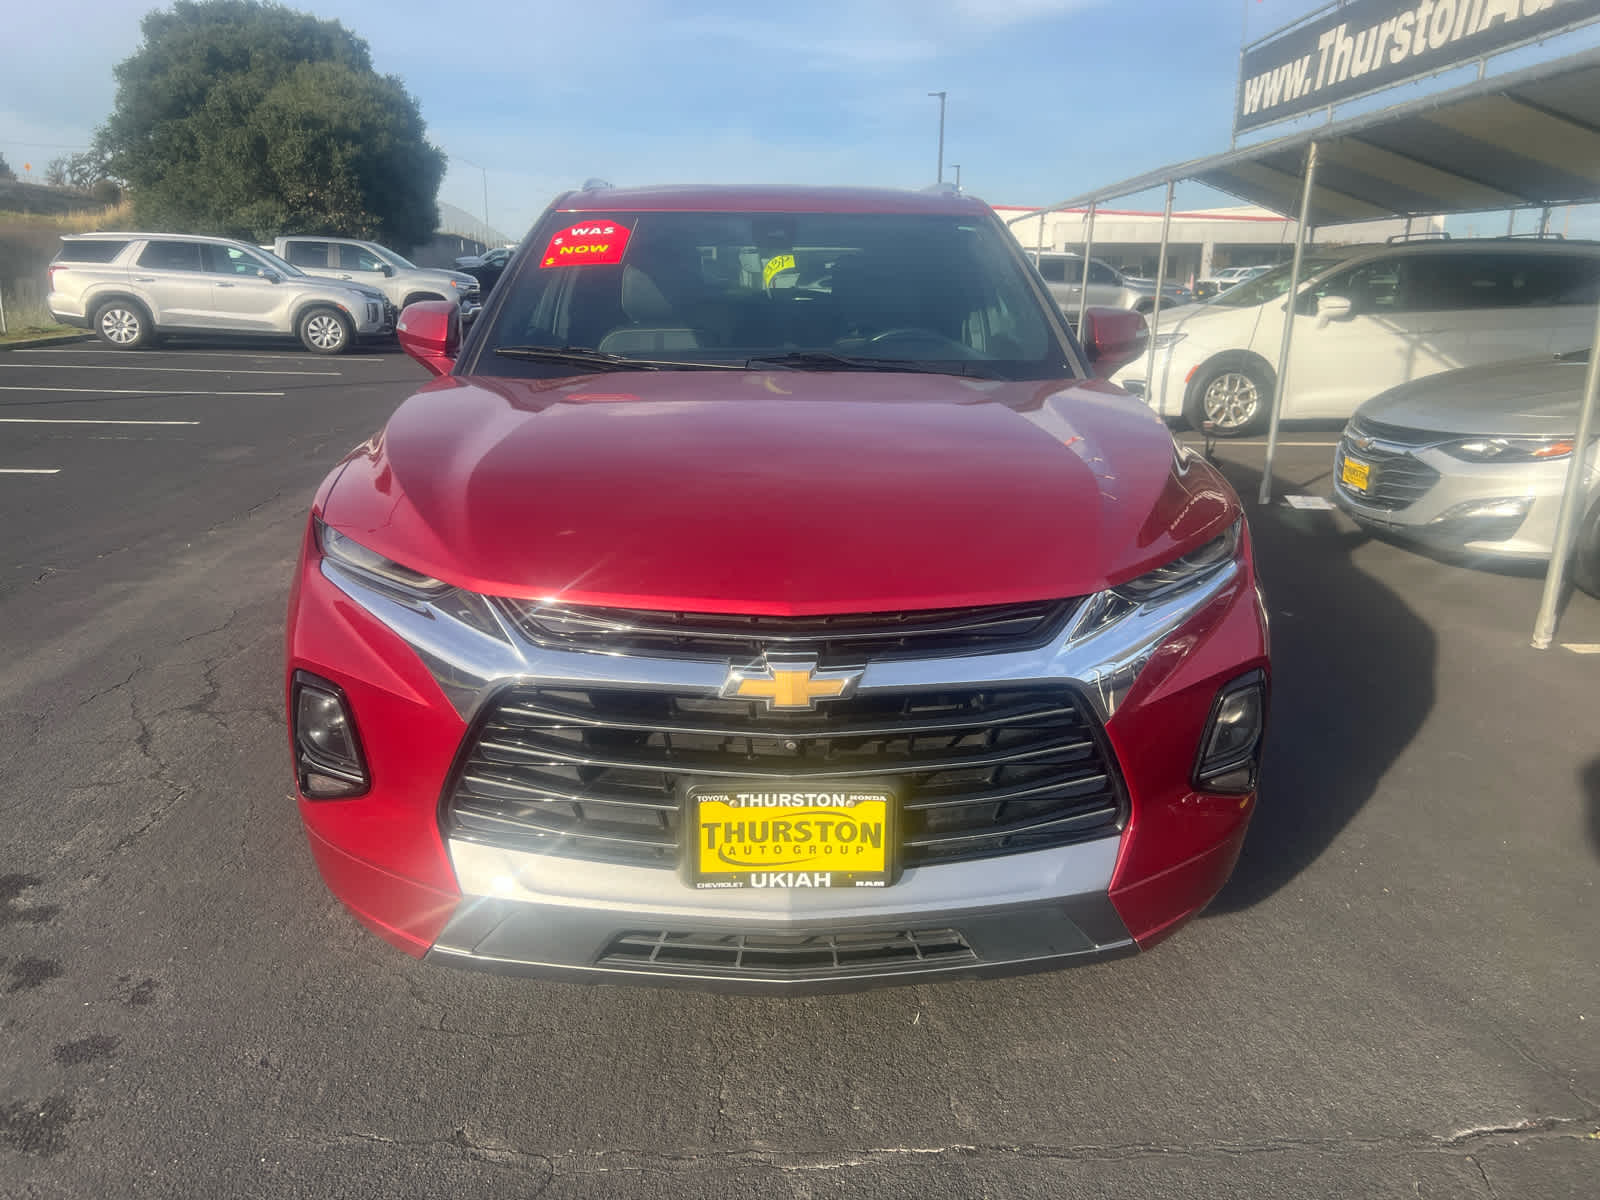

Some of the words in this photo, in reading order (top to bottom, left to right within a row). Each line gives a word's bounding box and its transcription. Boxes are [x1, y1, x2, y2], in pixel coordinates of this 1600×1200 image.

[1243, 0, 1552, 116] www.Thurston
[571, 227, 614, 236] WAS
[560, 244, 609, 255] NOW
[736, 794, 845, 807] THURSTON
[702, 821, 882, 849] THURSTON
[728, 845, 783, 855] AUTO
[793, 845, 864, 855] GROUP
[751, 873, 831, 888] UKIAH
